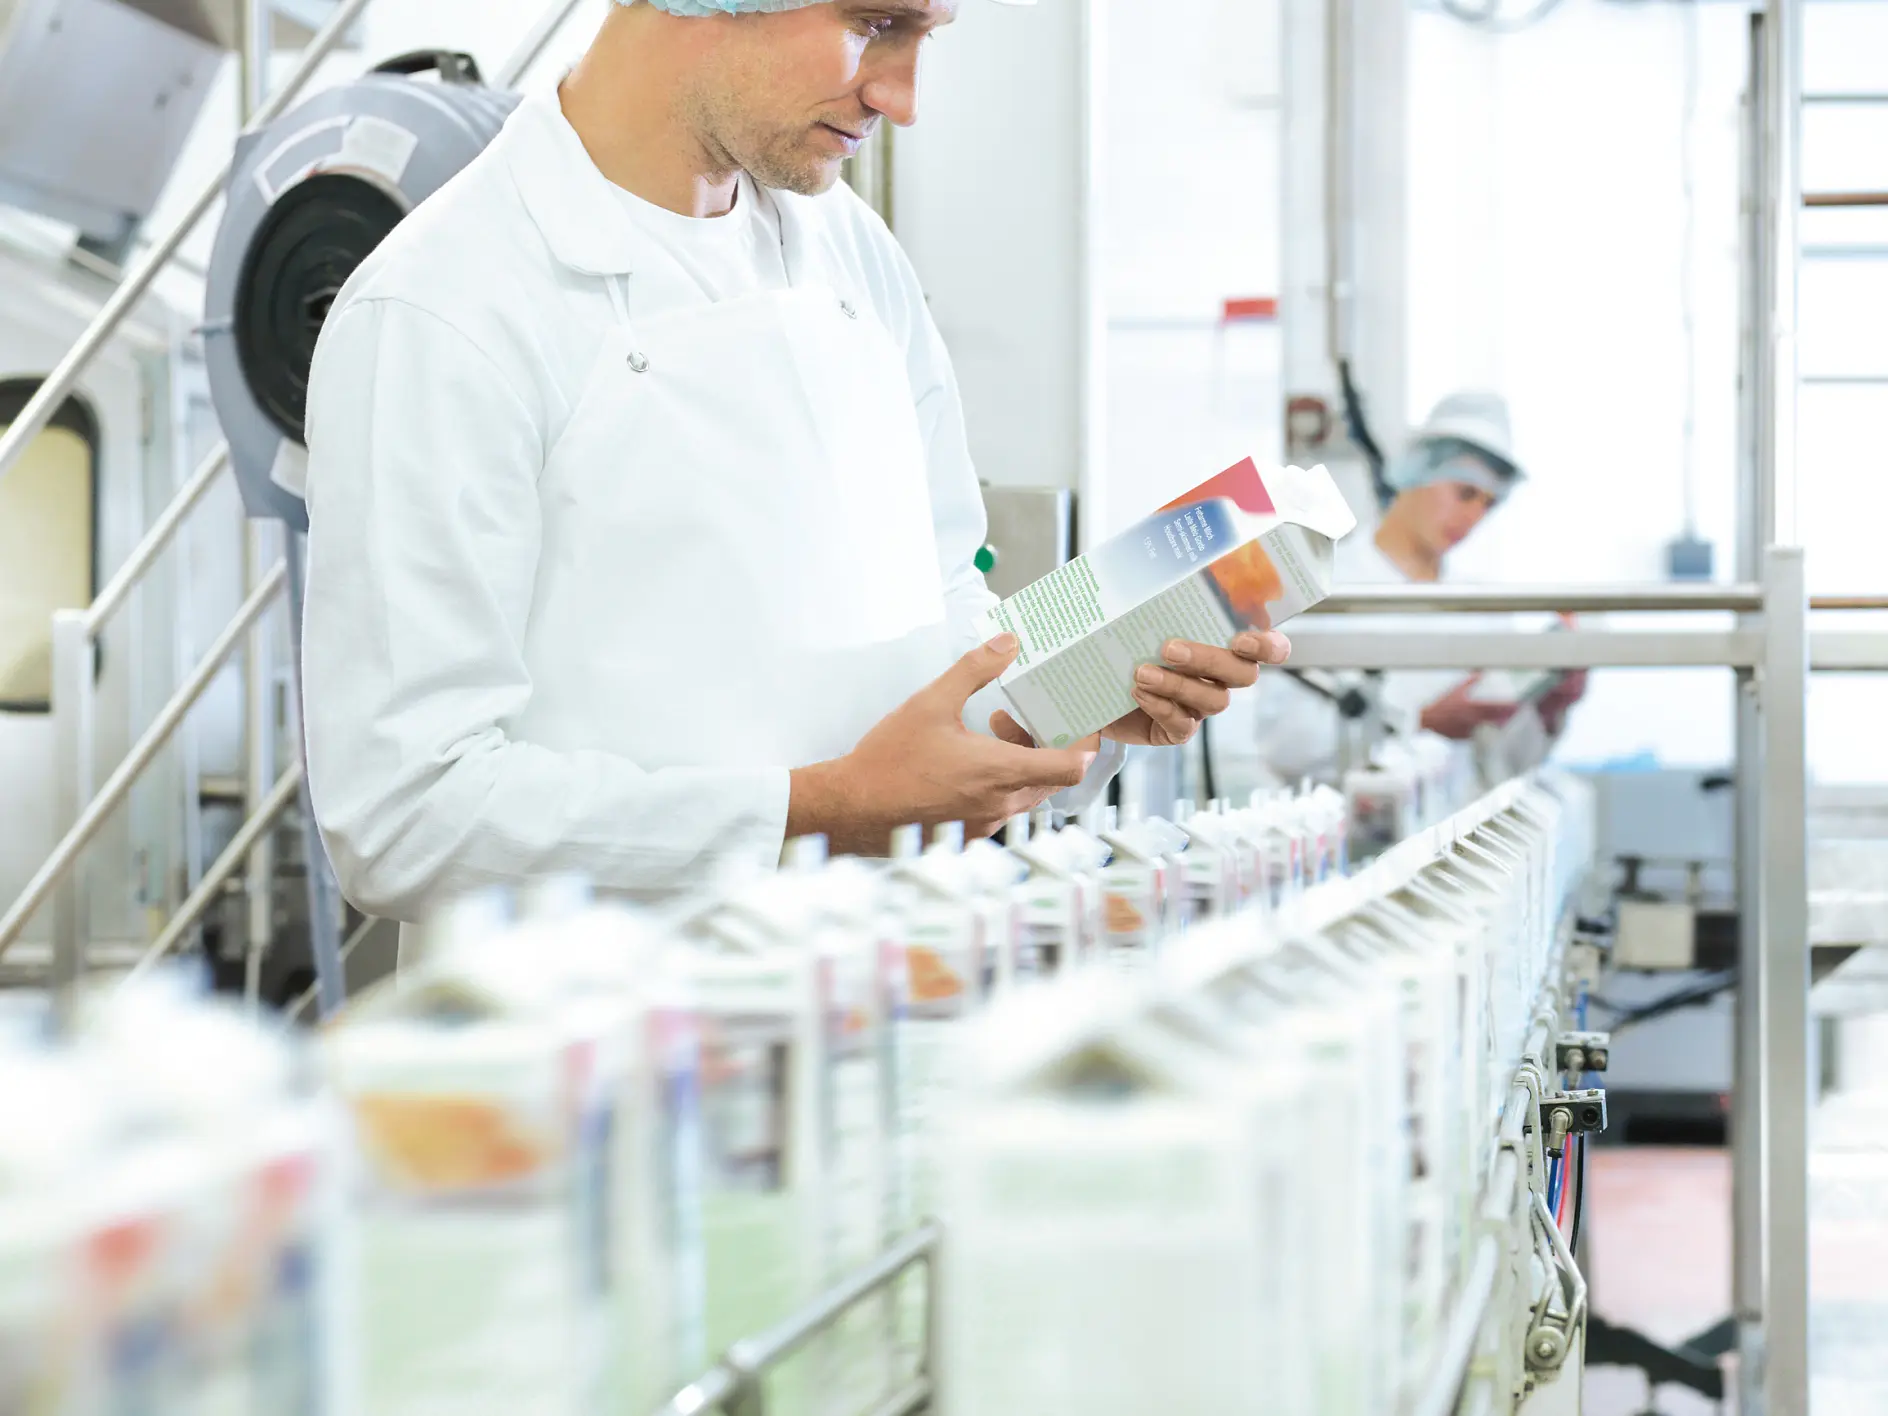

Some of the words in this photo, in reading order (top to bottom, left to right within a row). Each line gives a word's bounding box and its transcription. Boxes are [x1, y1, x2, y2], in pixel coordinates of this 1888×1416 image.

[1173, 518, 1194, 553] Semi-skimmed
[1184, 512, 1194, 526] Leite
[1194, 535, 1205, 552] Gordo
[1204, 526, 1214, 541] Milch
